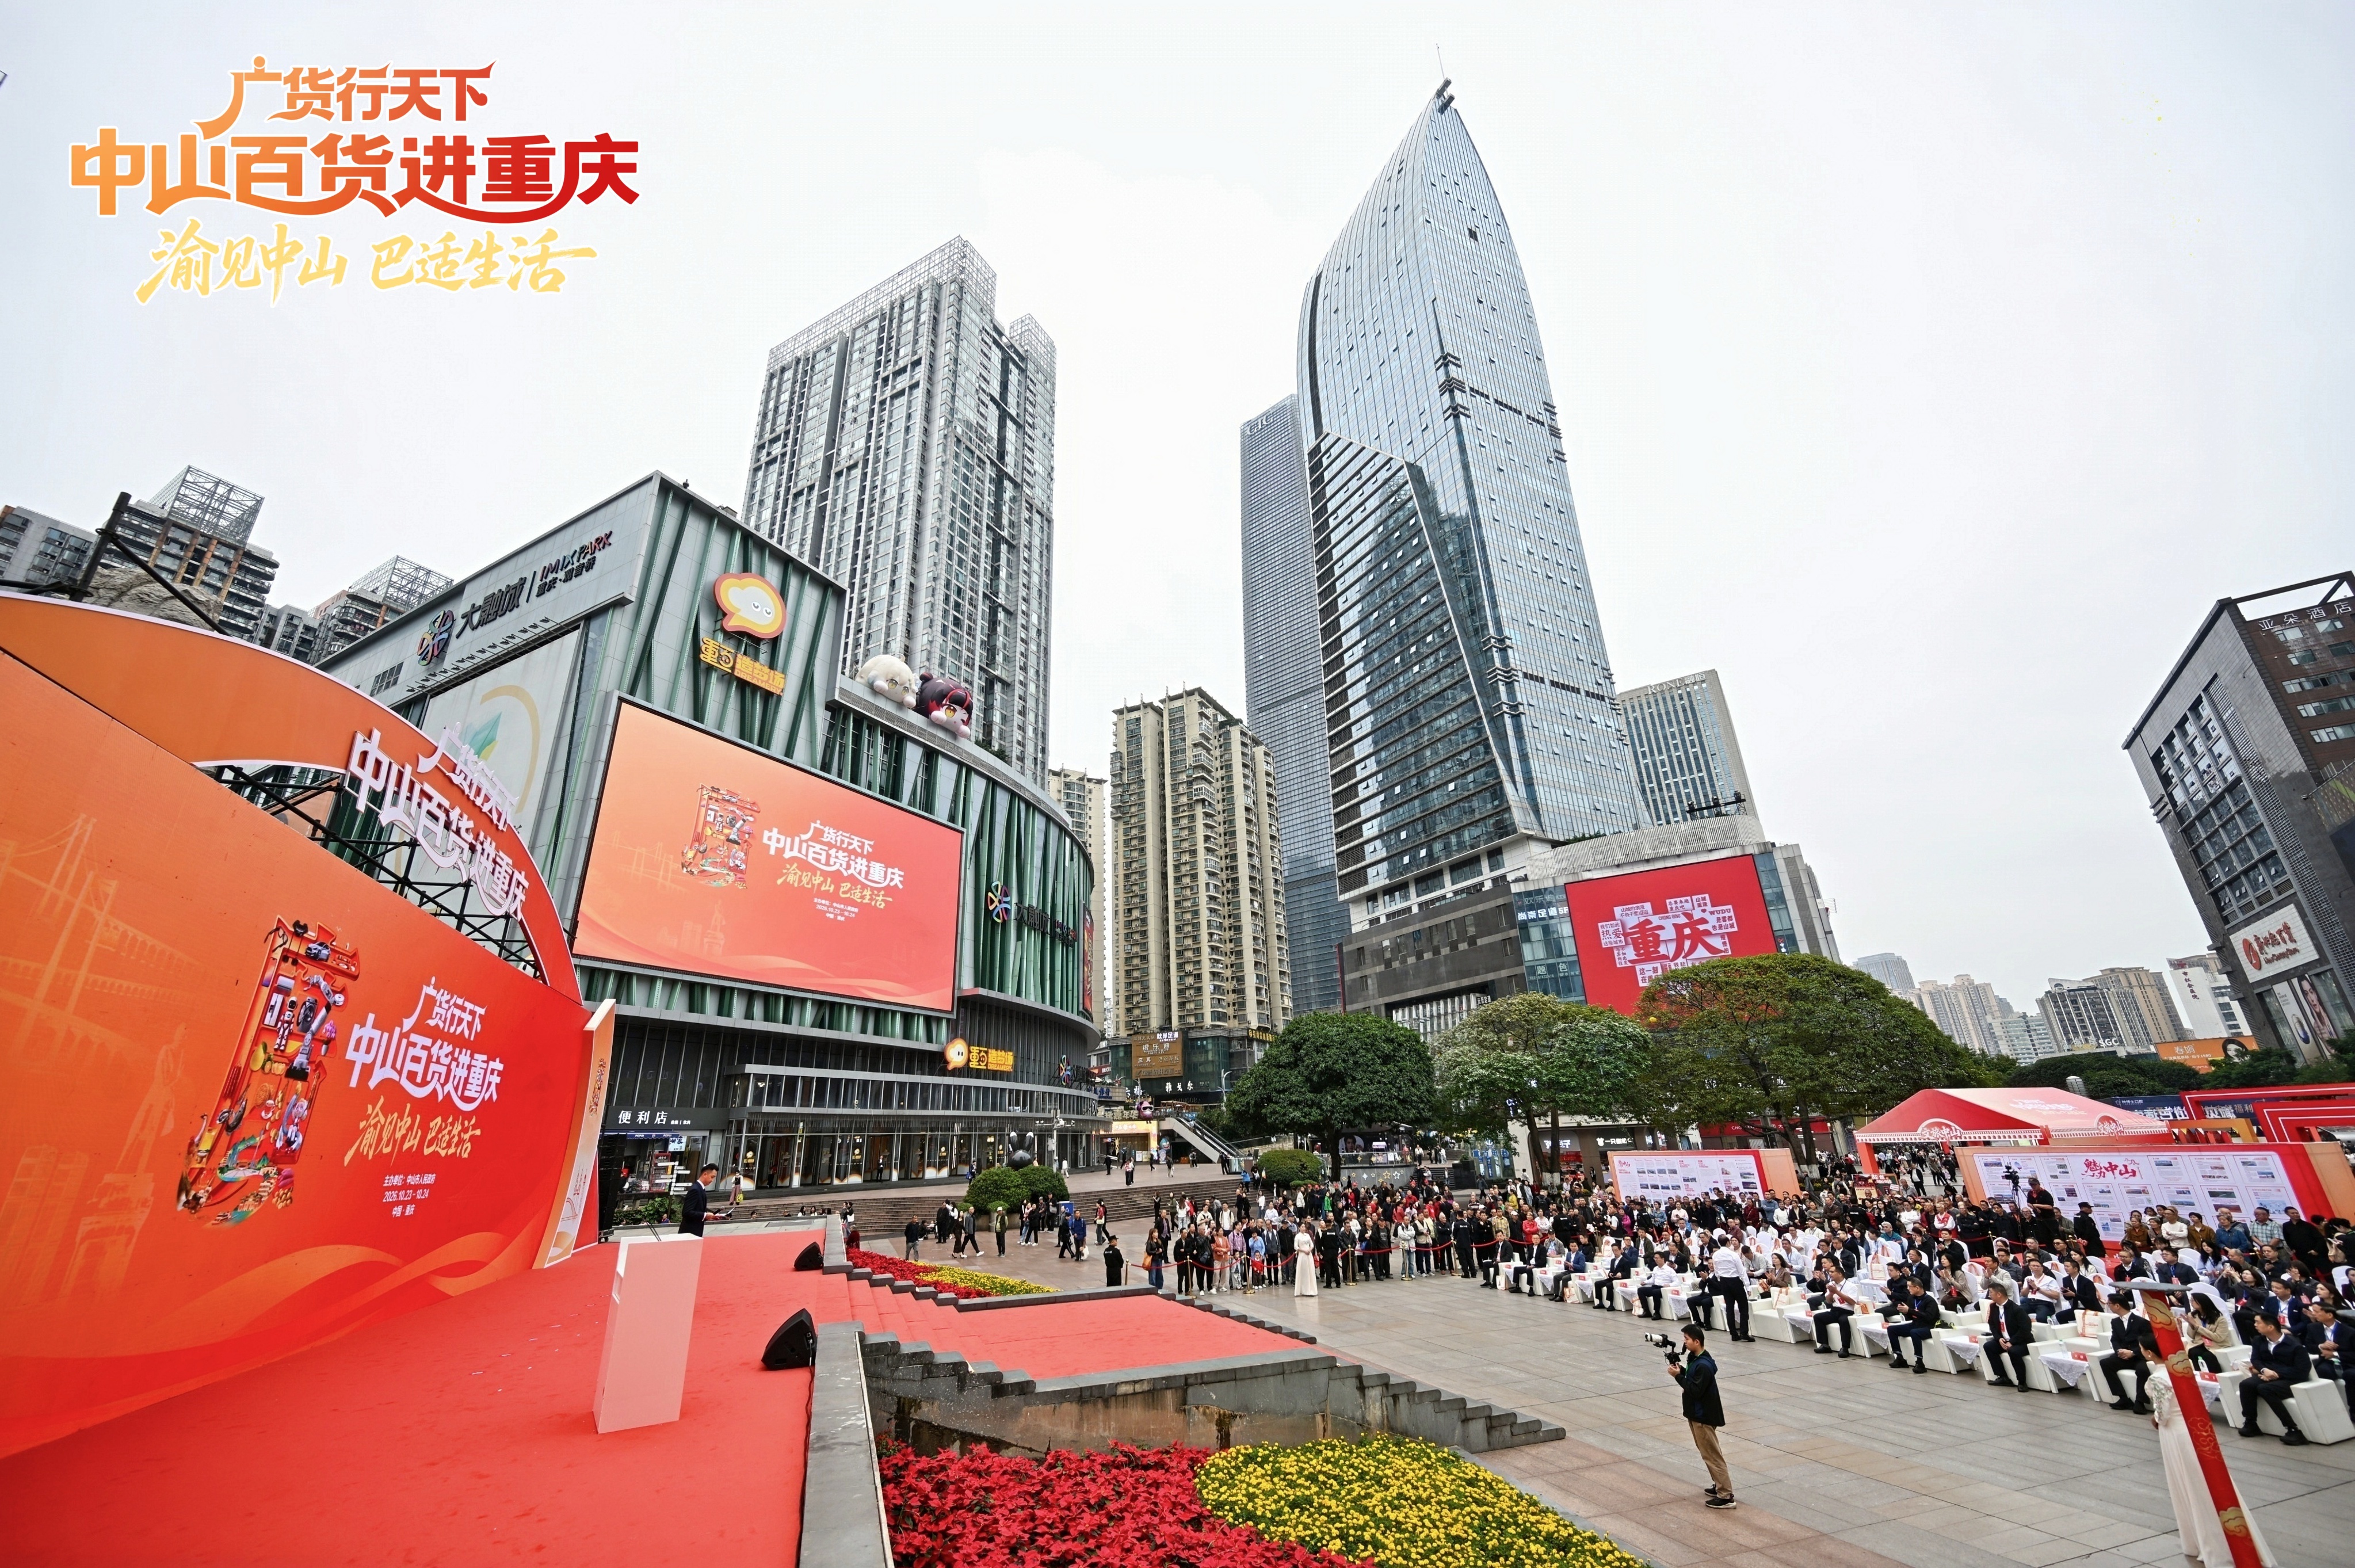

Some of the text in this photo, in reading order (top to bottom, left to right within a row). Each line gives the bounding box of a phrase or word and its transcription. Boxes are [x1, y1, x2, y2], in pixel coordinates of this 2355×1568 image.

[577, 531, 613, 562] PARK
[456, 577, 527, 639] 大融城
[417, 722, 519, 832] 广货行天下
[347, 727, 529, 922] 中山百货进重庆
[799, 819, 875, 855] 广货行天下
[762, 827, 904, 889] 中山百货进重庆
[777, 863, 893, 909] 渝见中山 巴适生活
[1601, 928, 1622, 940] 热爱
[1621, 912, 1726, 965] 重庆
[1712, 922, 1735, 931] 也是山城
[402, 976, 487, 1040] 广货行天下
[345, 1013, 503, 1111] 中山百货进重庆
[2098, 1037, 2120, 1047] SGC
[2174, 1045, 2196, 1055] 春娟
[1165, 1080, 1194, 1093] 雅戈尔
[344, 1095, 481, 1168] 渝见中山 巴适生活
[618, 1110, 667, 1124] 便利店
[2081, 1158, 2137, 1180] 魅力中山
